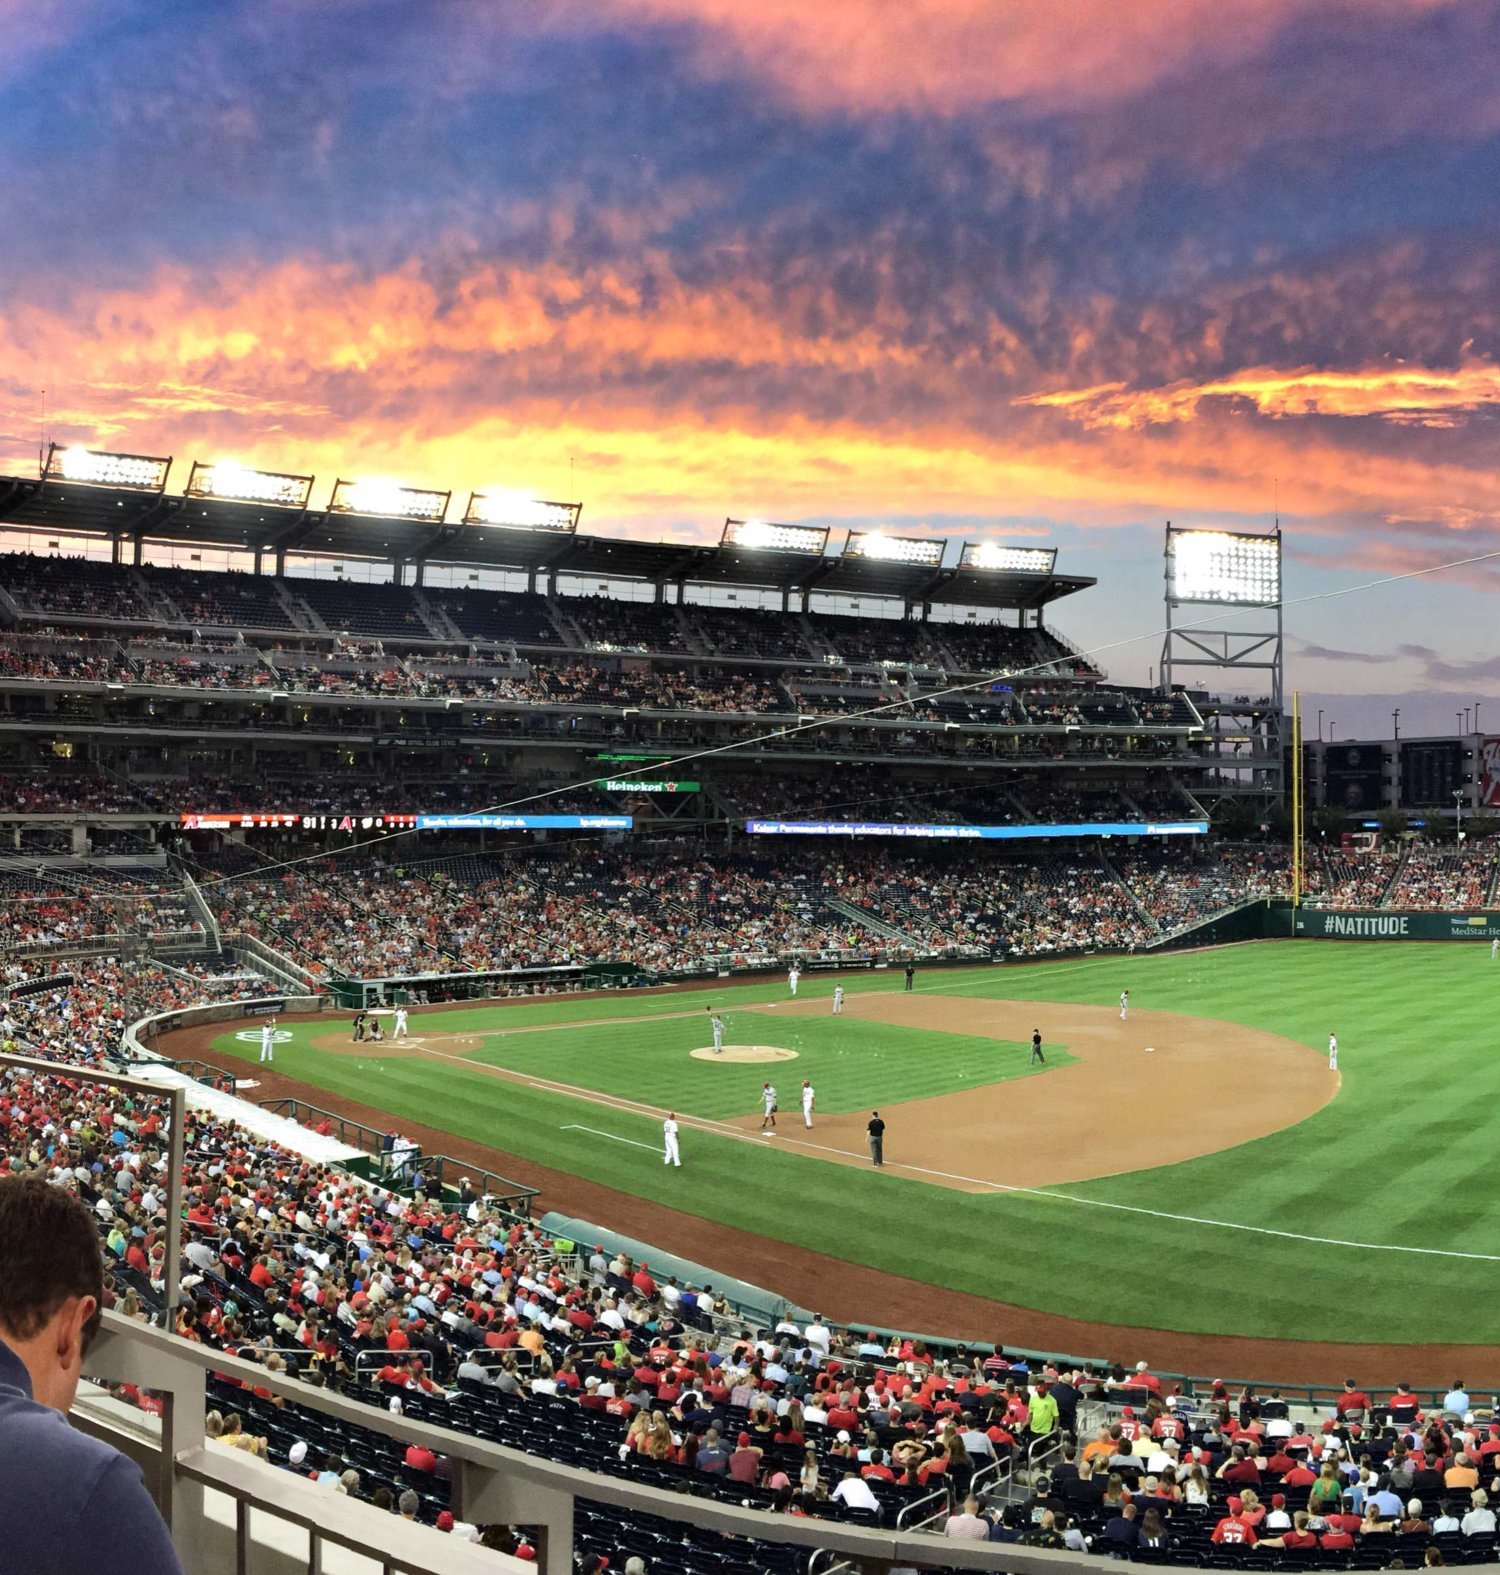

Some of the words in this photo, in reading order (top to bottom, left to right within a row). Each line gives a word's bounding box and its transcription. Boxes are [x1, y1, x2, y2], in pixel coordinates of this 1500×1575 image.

[606, 781, 660, 792] Heineken
[1325, 915, 1409, 935] #NATITUDE
[1451, 927, 1487, 936] MedStar
